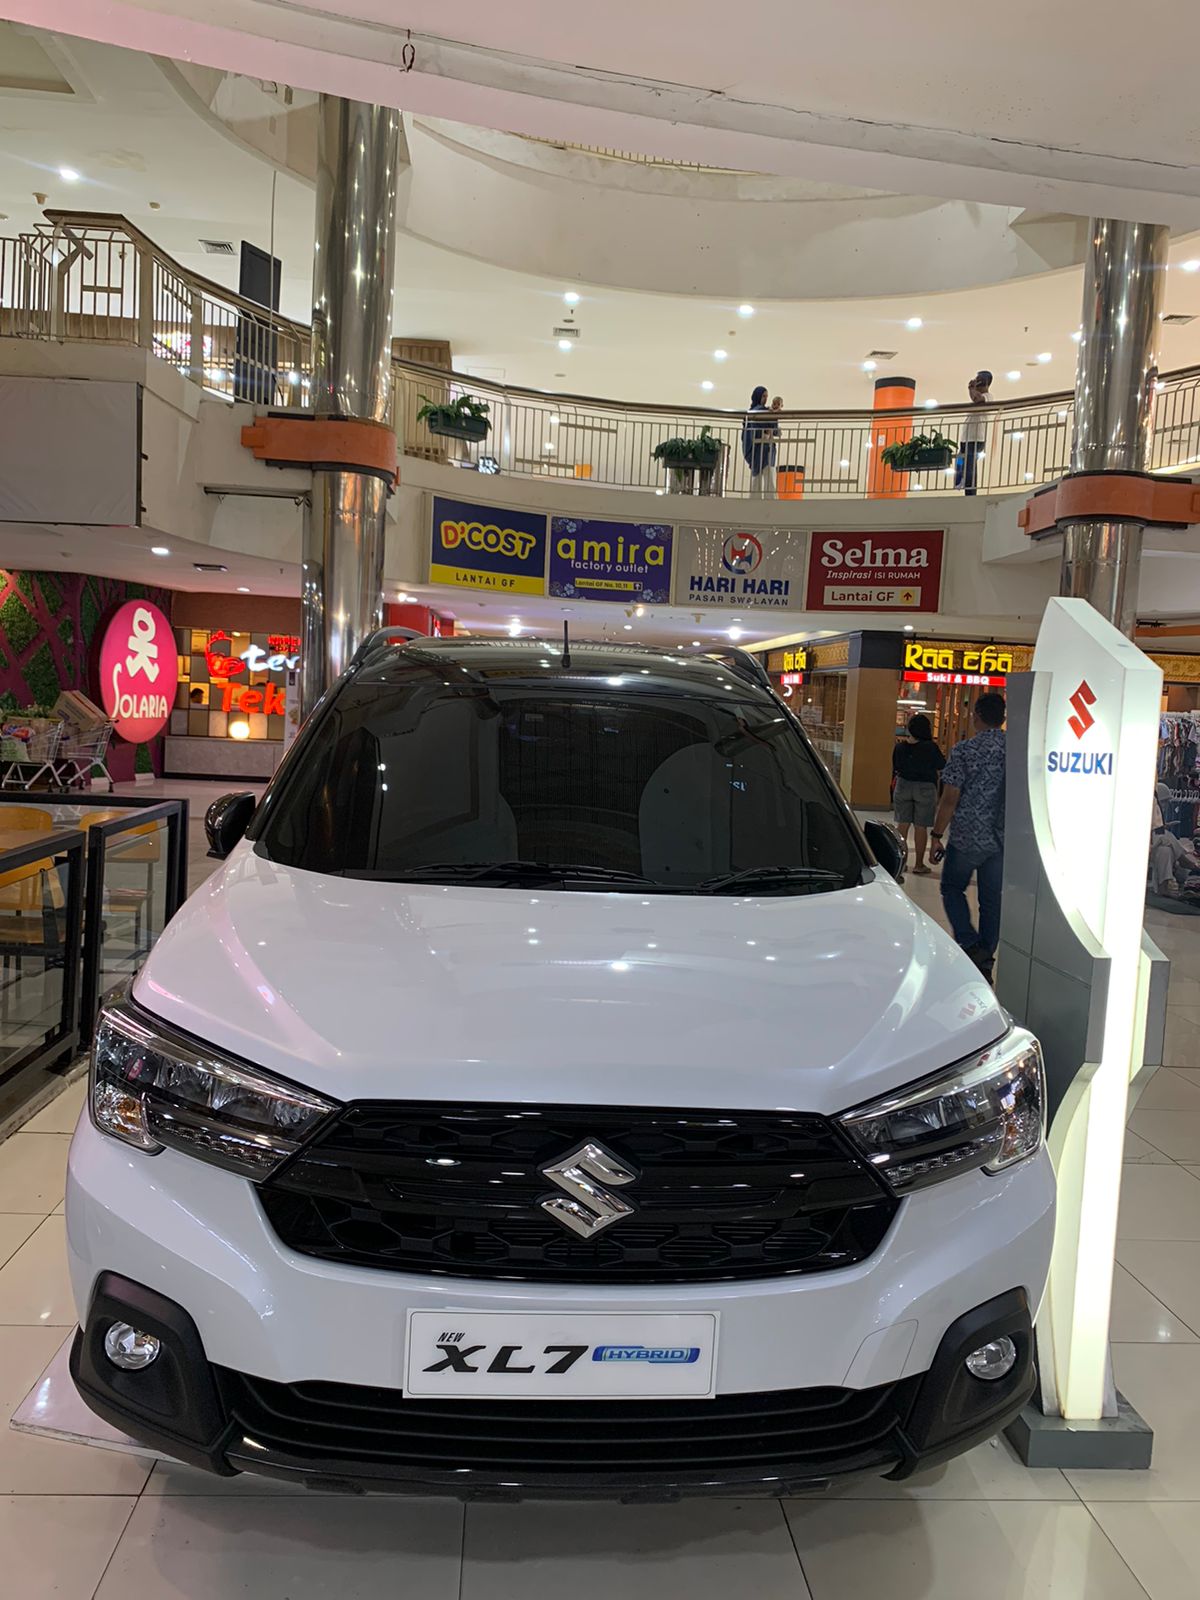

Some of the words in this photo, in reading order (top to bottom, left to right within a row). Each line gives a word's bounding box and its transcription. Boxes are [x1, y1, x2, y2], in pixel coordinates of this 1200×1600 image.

[440, 520, 537, 560] D'COST
[556, 536, 665, 566] amira
[820, 539, 929, 569] Selma
[570, 559, 612, 574] factory
[615, 561, 649, 574] outlet
[826, 570, 872, 581] Inspirasi
[874, 572, 886, 580] ISI
[887, 572, 921, 580] RUMAH
[455, 572, 496, 586] LANTAI
[501, 577, 516, 588] GF
[690, 576, 736, 594] HARI
[742, 578, 790, 597] HARI
[689, 594, 724, 604] PASAR
[730, 596, 789, 607] SWALAYAN
[831, 591, 873, 602] Lantai
[876, 591, 895, 602] GF
[926, 673, 951, 684] Suki
[954, 674, 963, 684] &
[966, 675, 990, 686] BBQ
[111, 663, 168, 719] SOLARIA
[1047, 751, 1113, 775] SUZUKI
[437, 1332, 466, 1343] NEW
[422, 1344, 590, 1374] XL7
[606, 1349, 687, 1361] HYBRID
